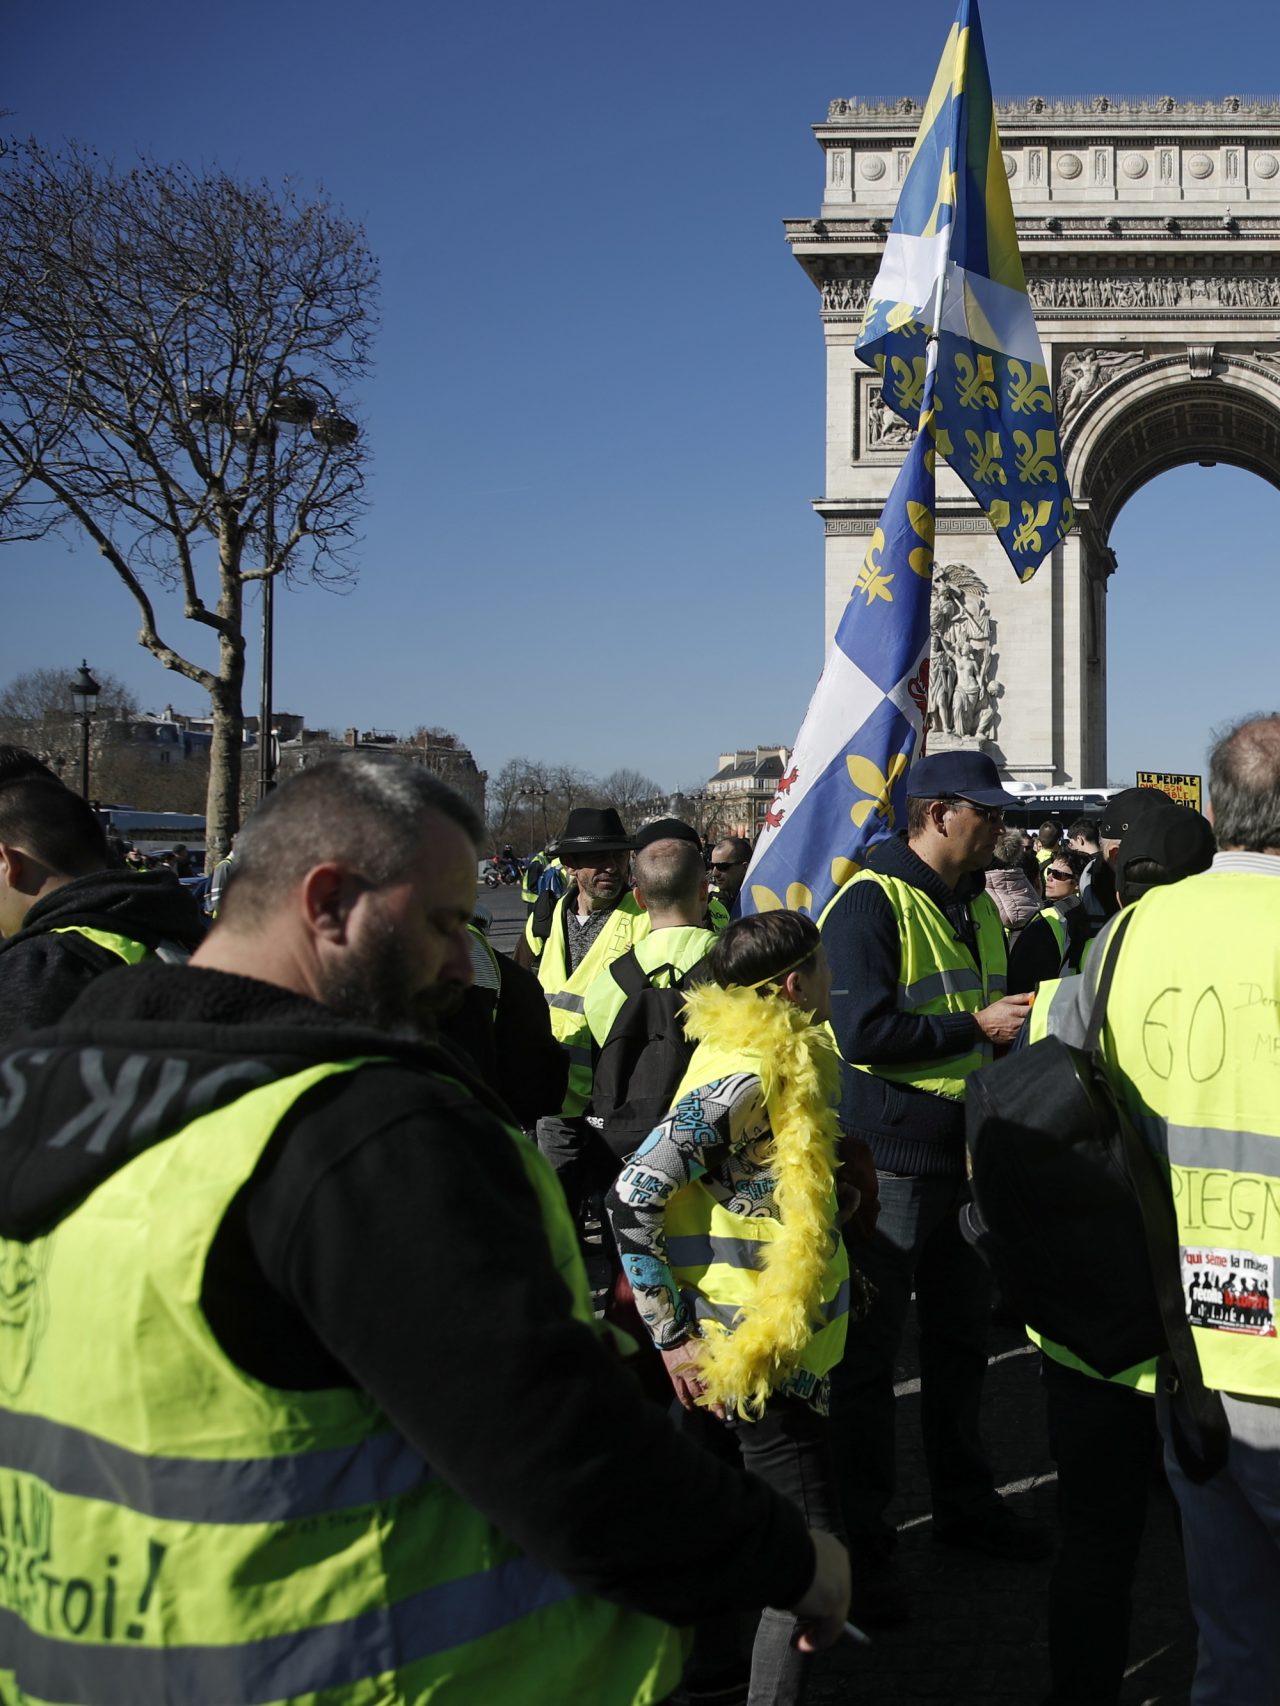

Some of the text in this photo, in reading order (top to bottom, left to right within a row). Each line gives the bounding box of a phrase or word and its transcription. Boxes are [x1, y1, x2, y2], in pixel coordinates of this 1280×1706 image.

[1141, 774, 1197, 787] LE PEUPLE
[630, 1171, 674, 1200] LIKE
[628, 1188, 652, 1204] IT
[1184, 1252, 1203, 1266] qui
[1230, 1255, 1241, 1269] la
